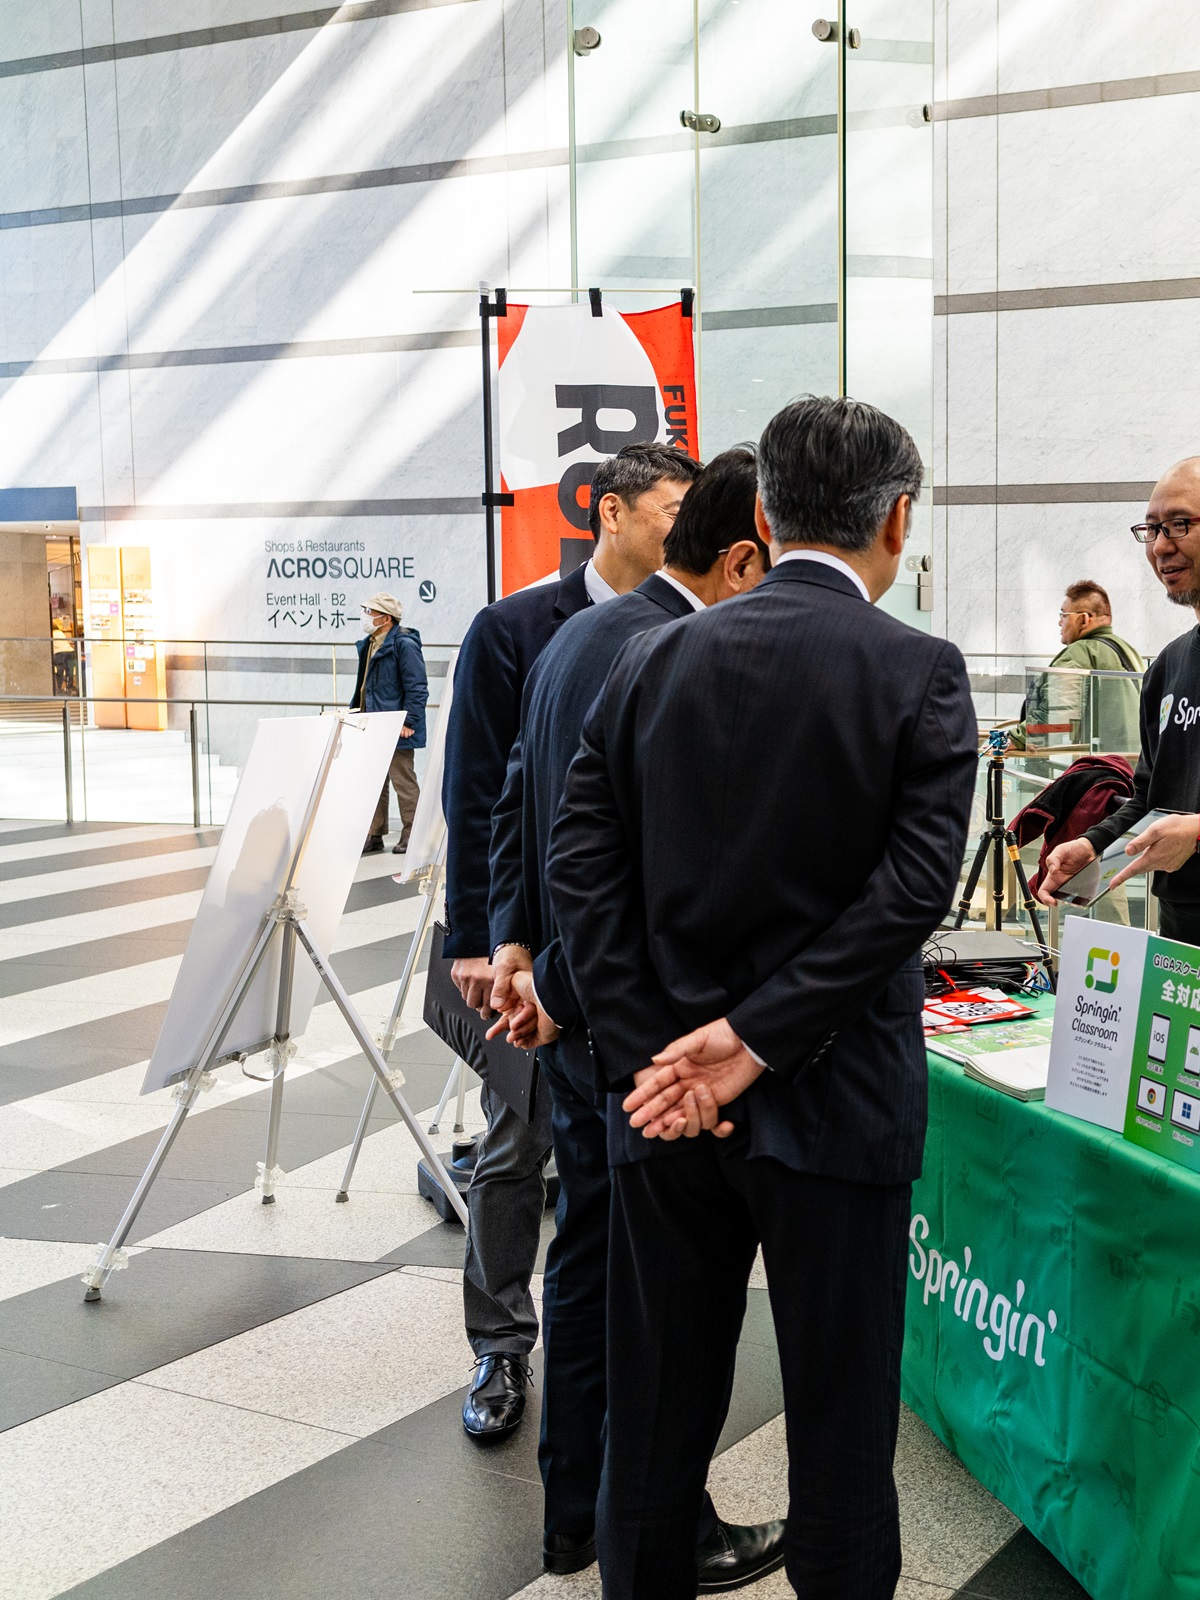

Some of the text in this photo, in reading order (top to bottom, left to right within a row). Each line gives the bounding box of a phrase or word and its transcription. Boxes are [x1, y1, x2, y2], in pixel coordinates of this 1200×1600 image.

[663, 385, 688, 447] FUK
[265, 540, 366, 554] Shops & Restaurants
[266, 592, 297, 606] Event
[299, 592, 321, 606] Hall
[331, 592, 346, 606] B2
[267, 608, 361, 629] イベントホー
[1075, 995, 1122, 1024] Springin'
[1071, 1018, 1118, 1042] Classroom
[1153, 1031, 1166, 1044] iOS
[909, 1213, 1058, 1367] Springin'
